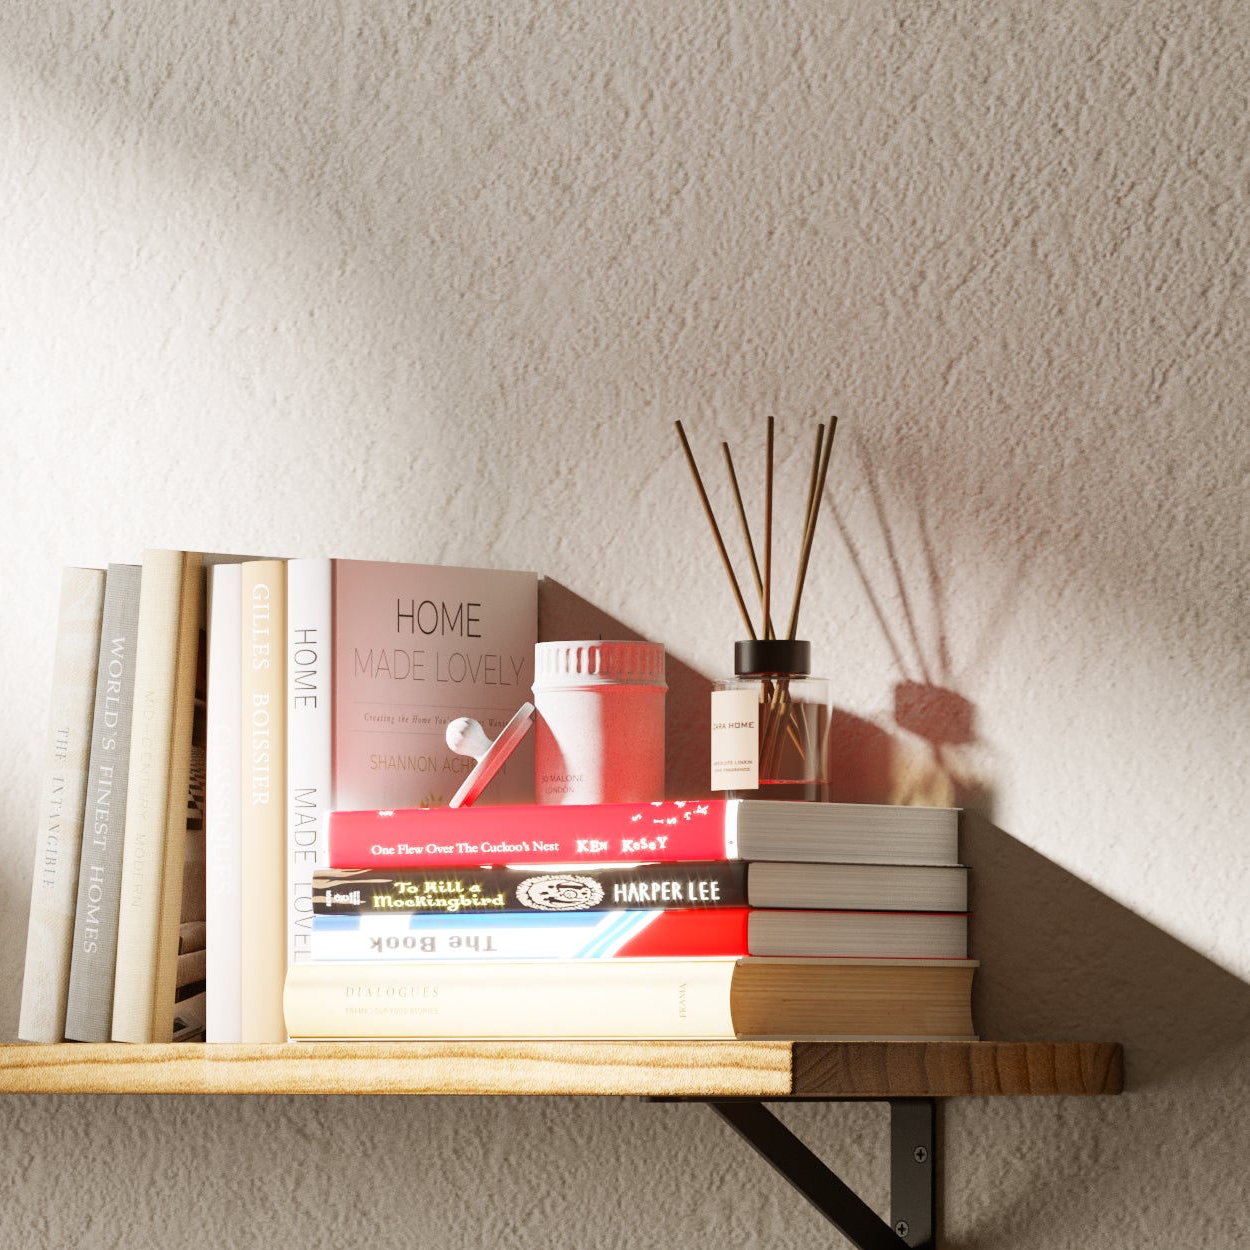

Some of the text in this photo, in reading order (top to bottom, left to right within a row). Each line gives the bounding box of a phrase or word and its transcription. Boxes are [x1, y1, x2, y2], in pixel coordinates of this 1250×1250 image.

[397, 598, 482, 638] HOME
[353, 648, 525, 686] MADE LOVELY
[252, 583, 270, 807] GILLES BOISSIER
[363, 712, 395, 724] Creating
[398, 714, 410, 724] the
[411, 714, 431, 724] Home
[728, 721, 755, 729] HOME
[370, 754, 437, 773] SHANNON
[549, 774, 585, 783] MALONE
[83, 636, 125, 953] WORLD'S FINEST HOMES
[294, 629, 318, 963] HOME MADE LOVEL
[545, 786, 575, 794] LONDON
[42, 727, 69, 889] THE INTANGIBLE
[370, 844, 396, 856] One
[397, 843, 424, 855] Flew
[425, 843, 455, 854] Over
[455, 842, 479, 854] The
[480, 841, 530, 853] Cuckoo's
[532, 840, 559, 852] Nest
[131, 834, 147, 907] MODERN
[393, 880, 482, 894] To Kill a
[613, 880, 721, 902] HARPER LEE
[372, 894, 506, 911] Mockingbird
[368, 935, 498, 953] The Book
[345, 985, 439, 999] DIALOGUES
